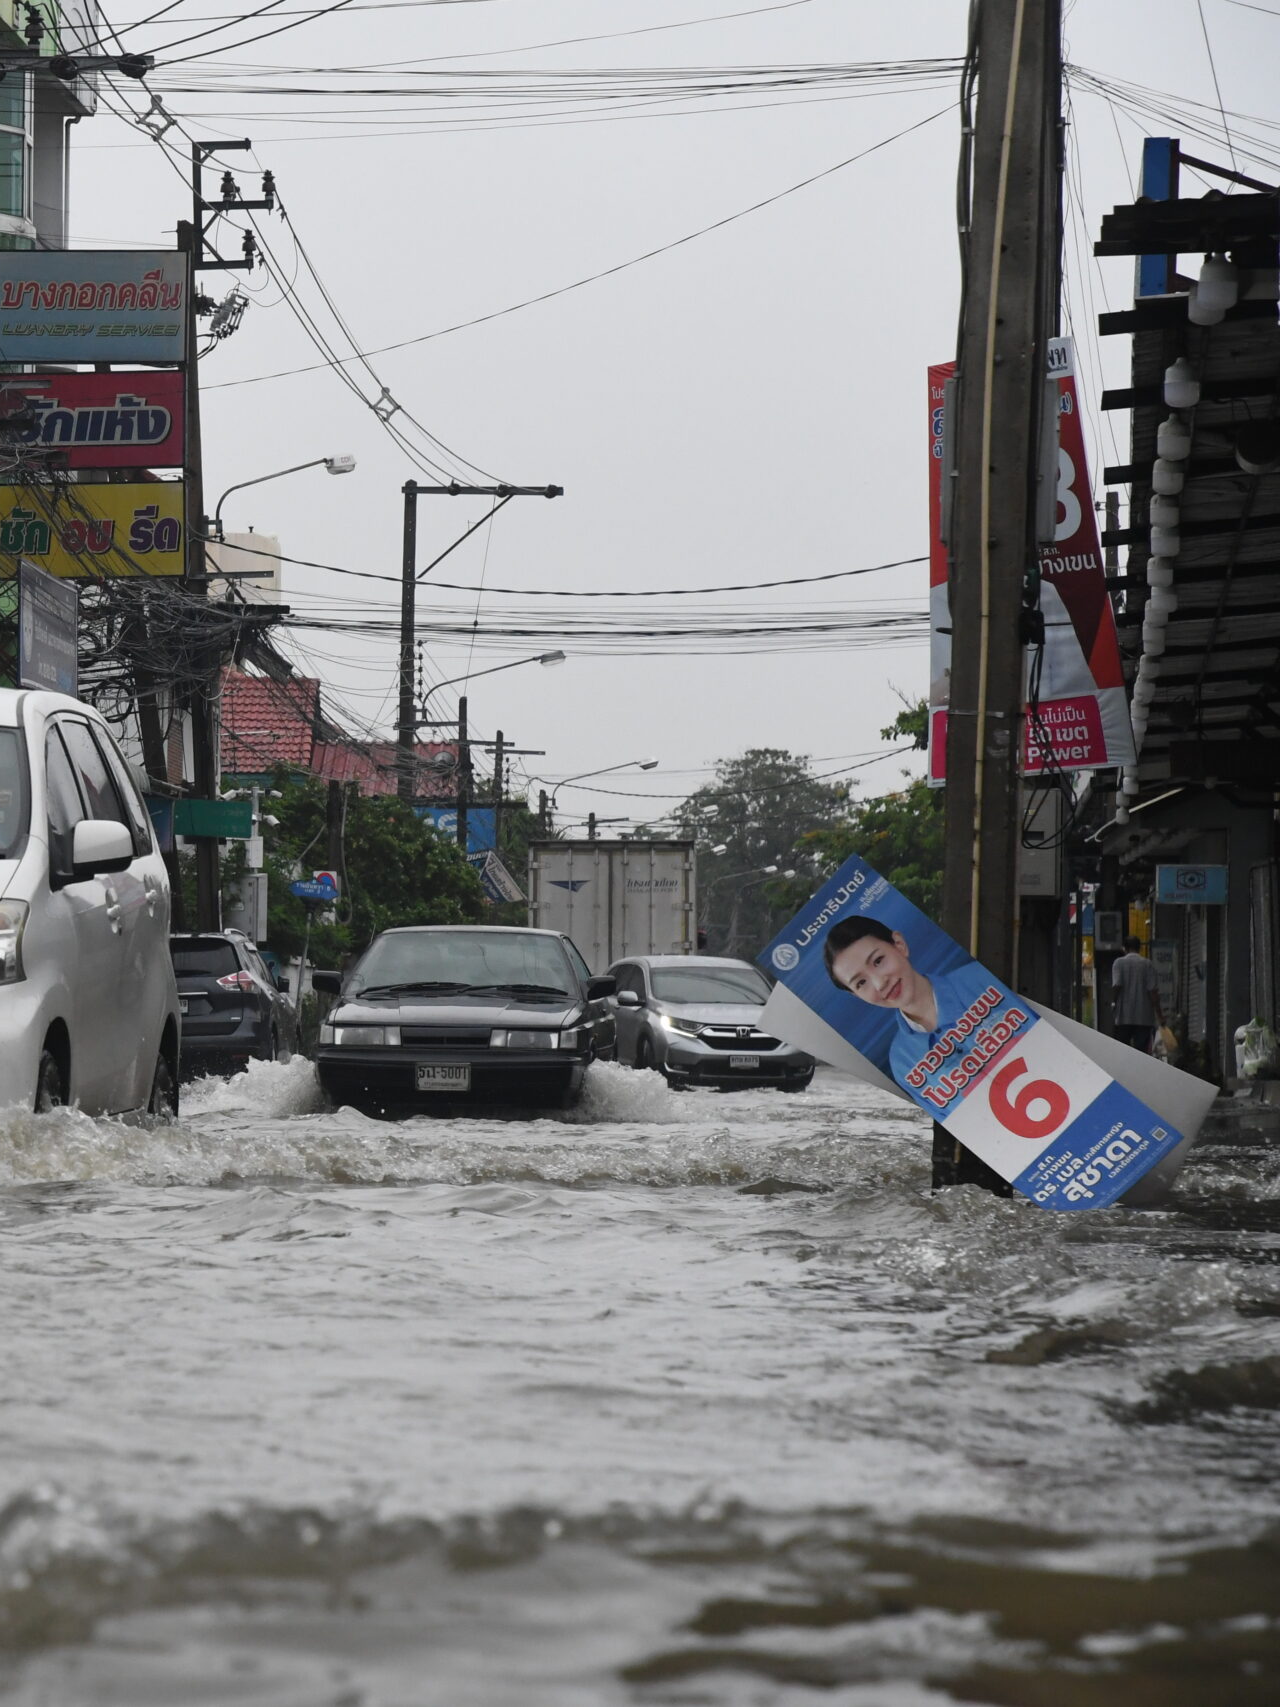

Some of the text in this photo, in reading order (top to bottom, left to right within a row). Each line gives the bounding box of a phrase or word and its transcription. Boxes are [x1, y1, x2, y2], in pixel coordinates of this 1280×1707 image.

[0, 269, 182, 311] บางกอกคลีน
[96, 324, 180, 337] SERVICE
[129, 505, 181, 552] รีด
[1028, 745, 1091, 763] Power
[1056, 726, 1089, 742] เขต
[796, 869, 866, 946] ประชาธิปัตย์
[905, 986, 1004, 1088] ชาวบางเขน
[922, 1008, 1027, 1108] โปรดเลือก
[989, 1056, 1070, 1139] 6
[1034, 1183, 1060, 1202] ดร.
[1056, 1157, 1085, 1183] เบล
[1040, 1151, 1073, 1181] บางเขน
[1062, 1129, 1143, 1202] สุชาดา
